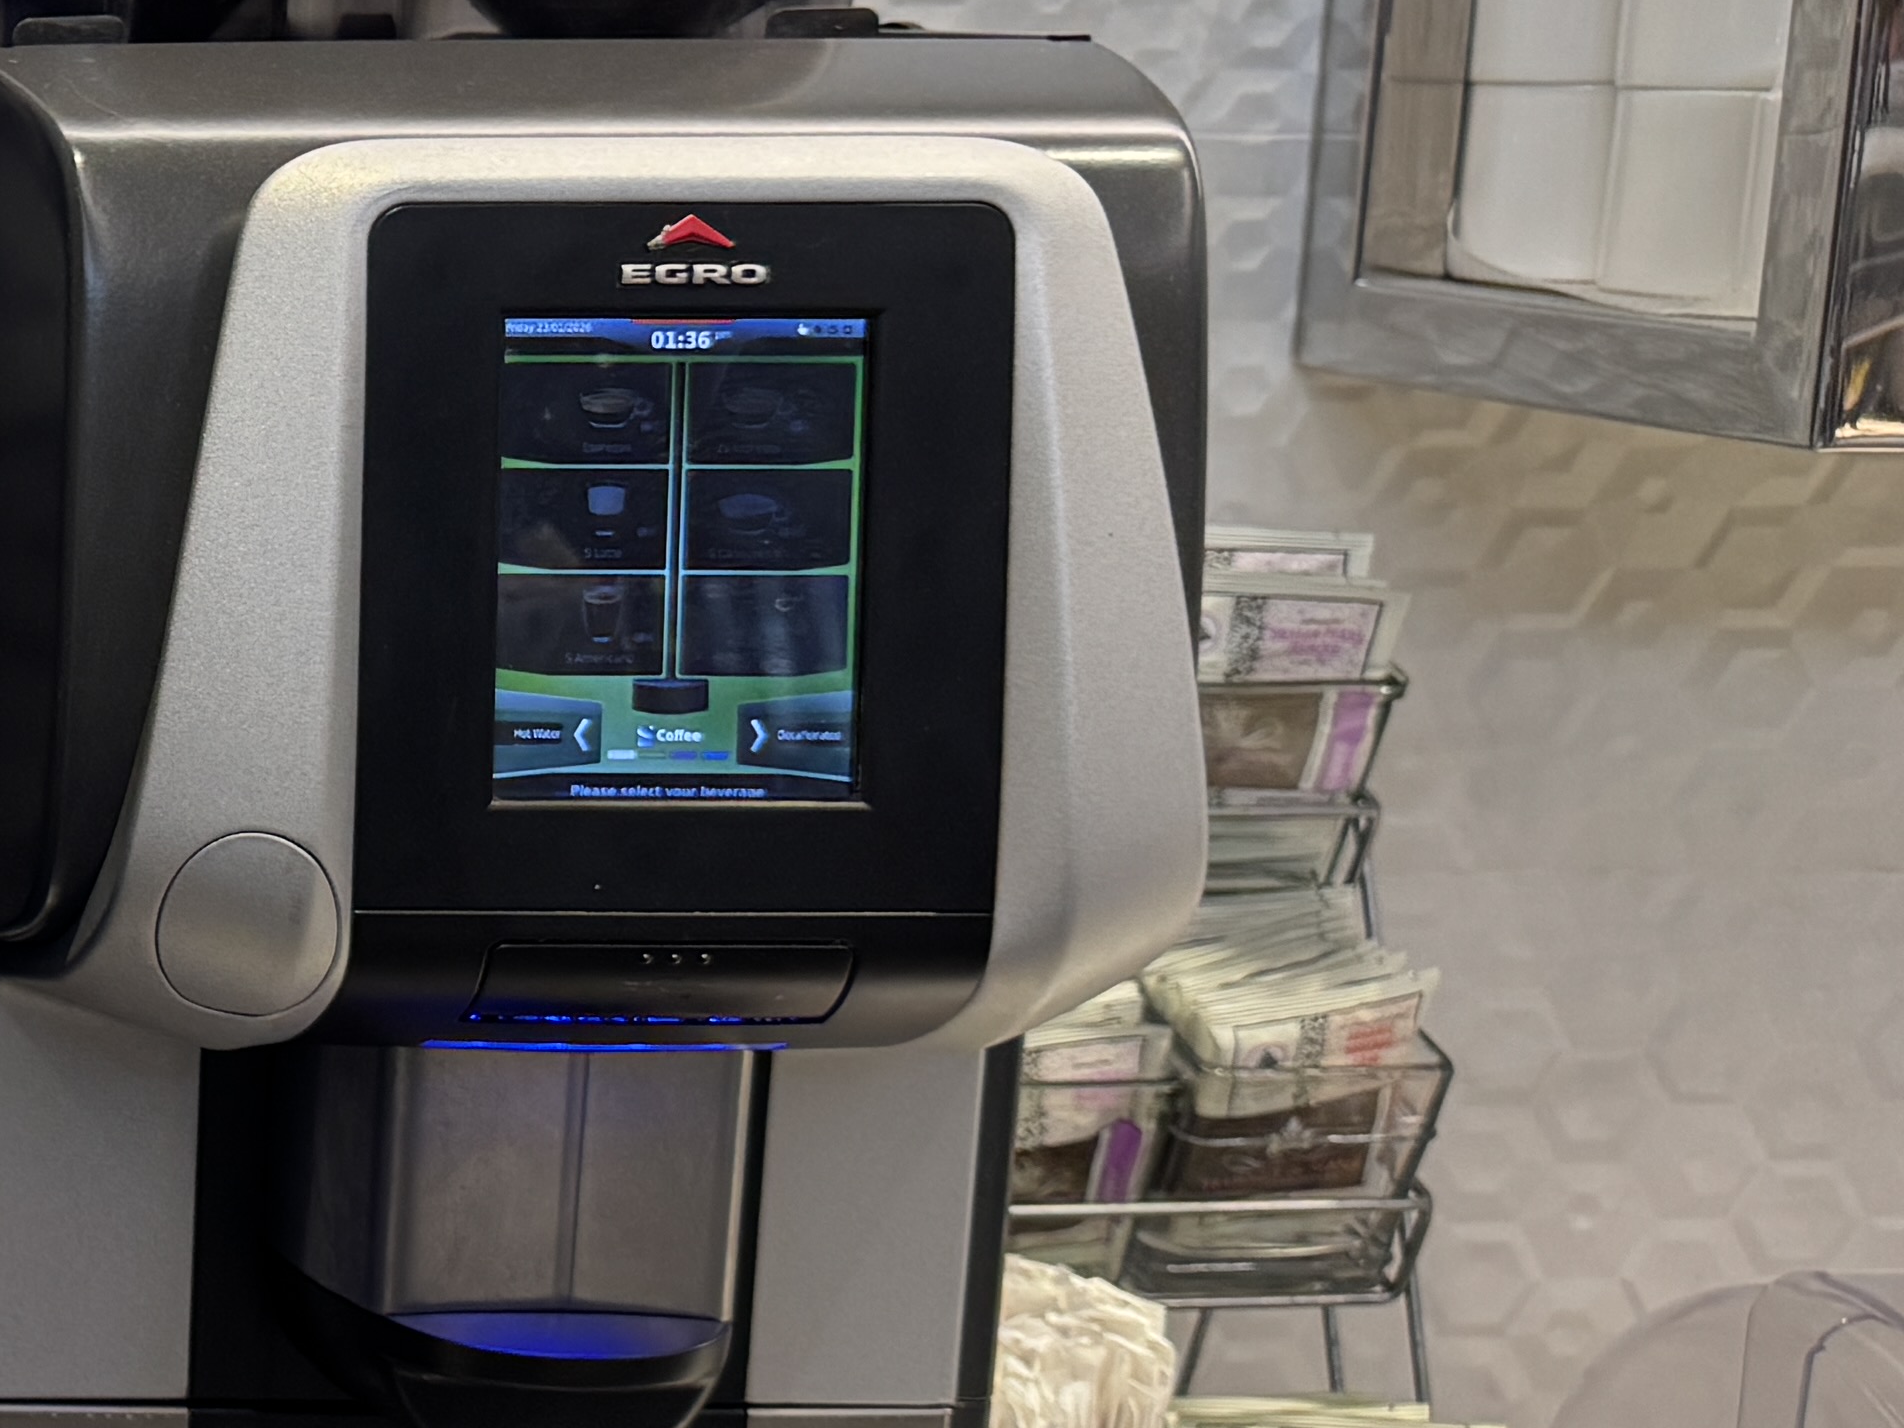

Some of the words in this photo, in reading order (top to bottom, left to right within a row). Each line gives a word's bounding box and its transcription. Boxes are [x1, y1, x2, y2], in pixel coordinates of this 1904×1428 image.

[619, 264, 770, 286] EGRO
[650, 331, 712, 349] 01:36
[656, 728, 702, 743] Coffee
[570, 784, 616, 798] Please
[620, 785, 662, 798] select
